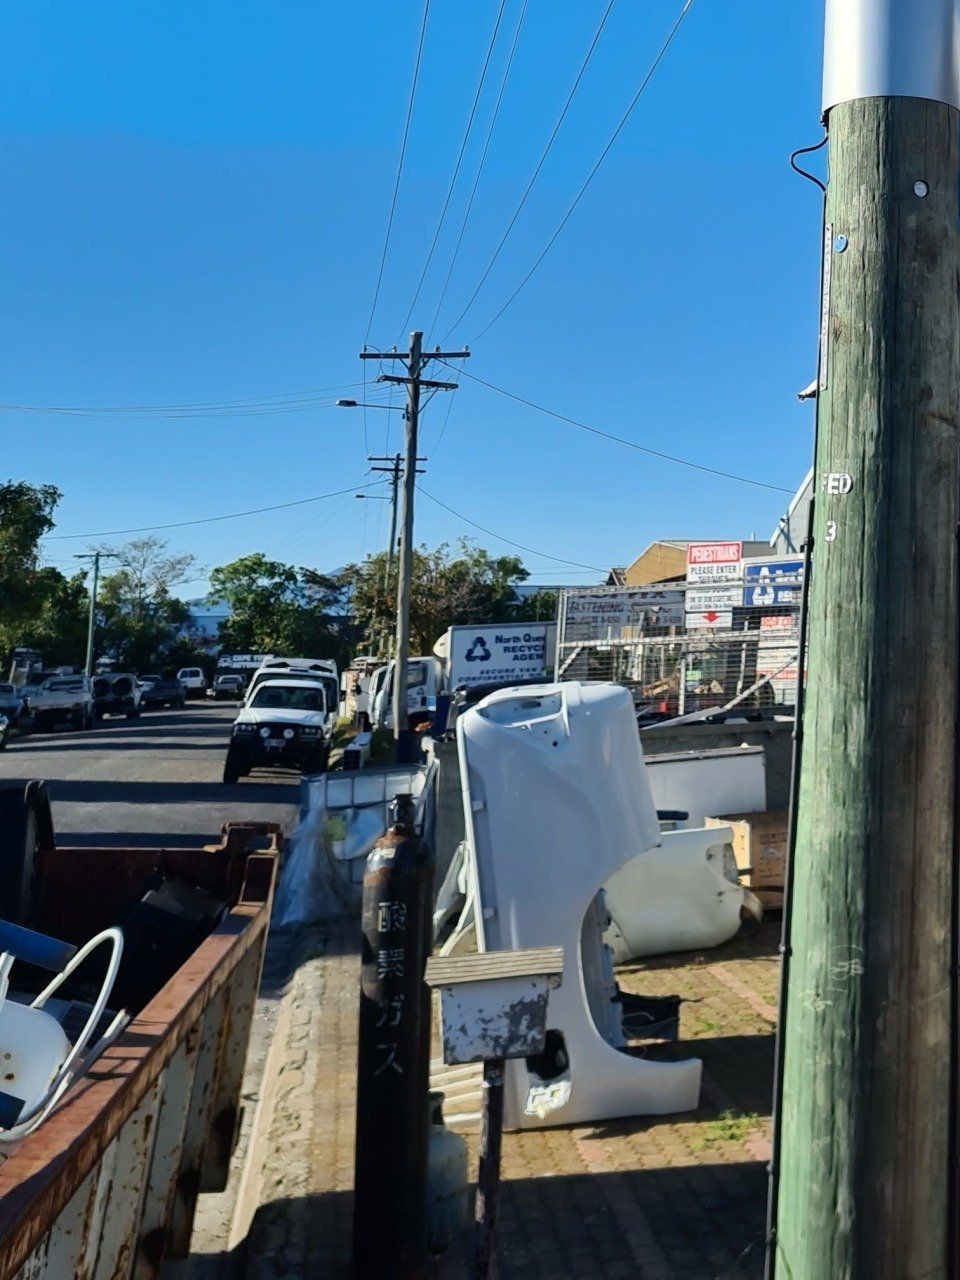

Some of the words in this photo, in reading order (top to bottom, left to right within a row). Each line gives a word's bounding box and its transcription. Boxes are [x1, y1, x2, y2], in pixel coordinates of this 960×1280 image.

[825, 520, 837, 542] 3
[691, 566, 714, 575] PLEASE
[716, 565, 737, 574] ENTER
[495, 634, 521, 644] North
